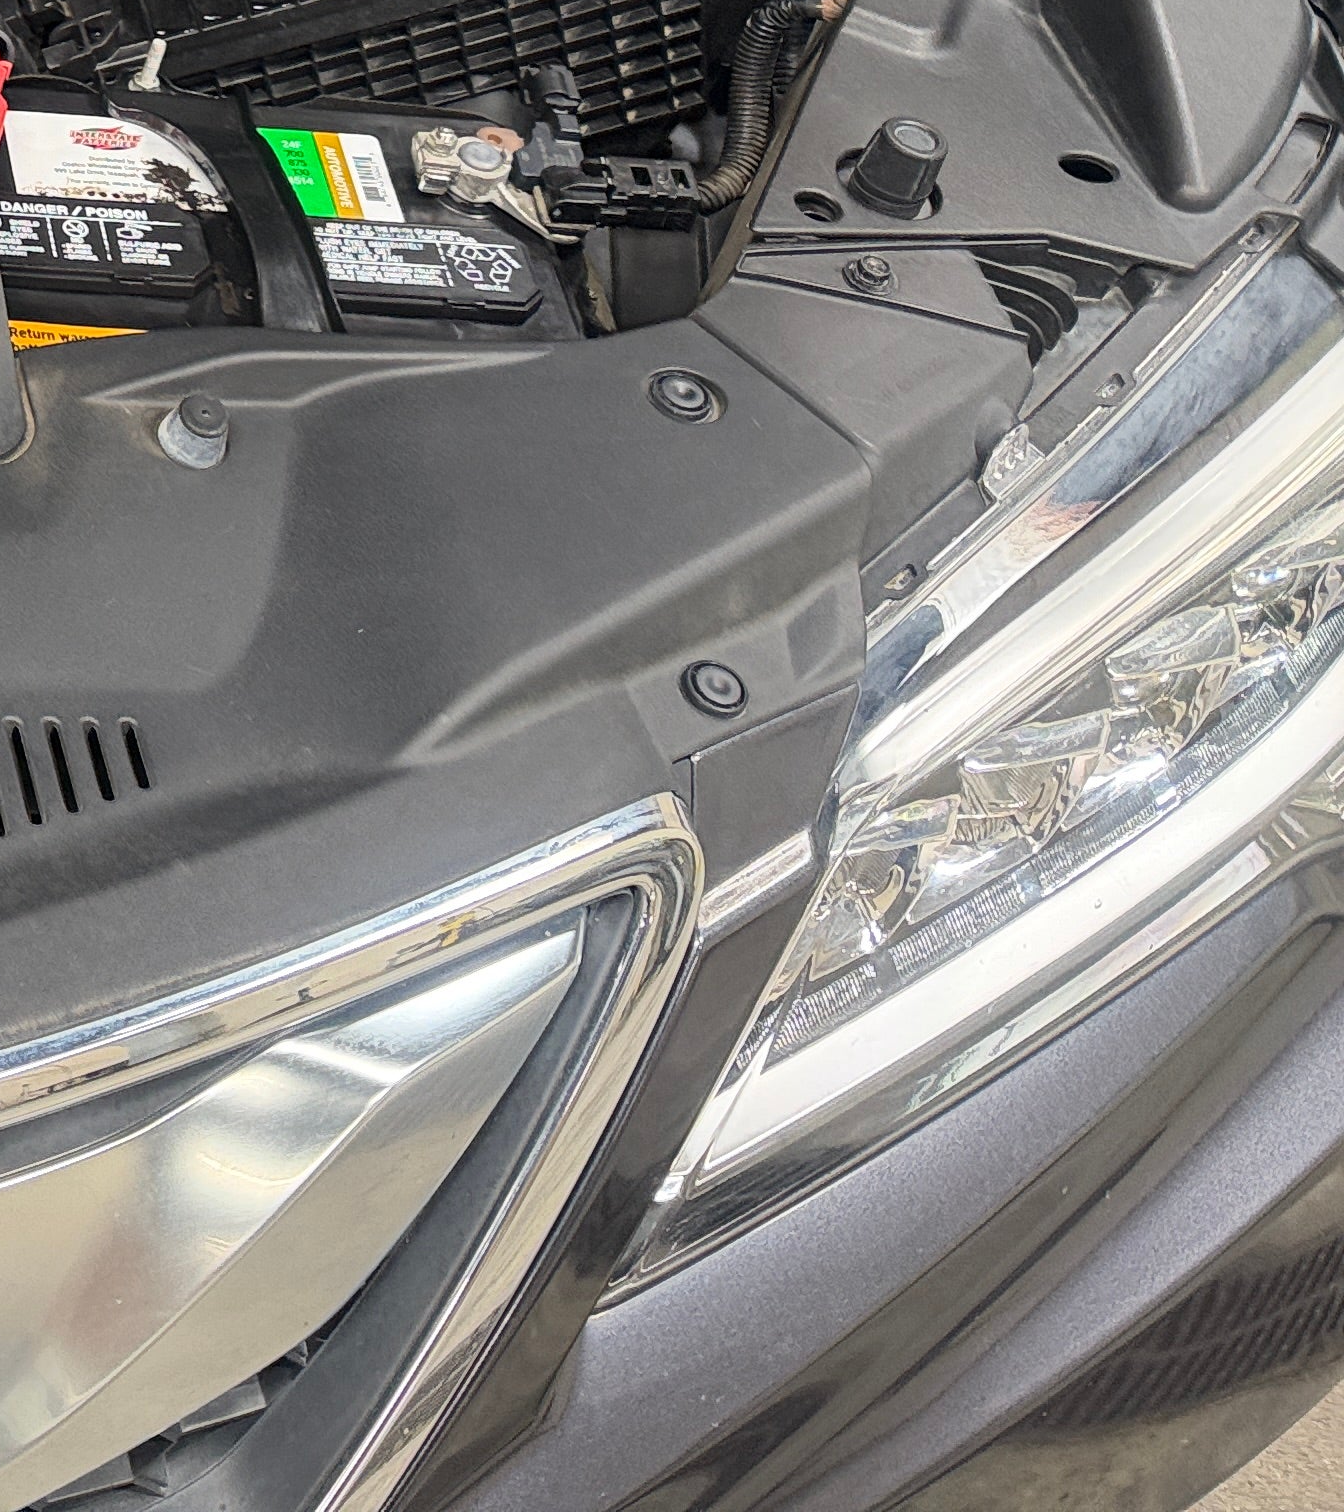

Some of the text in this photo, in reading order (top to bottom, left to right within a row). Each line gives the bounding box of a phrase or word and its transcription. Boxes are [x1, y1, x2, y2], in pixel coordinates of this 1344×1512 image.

[70, 129, 143, 142] INTERSTATE
[72, 138, 138, 148] BATTERIES
[282, 149, 304, 157] 700
[322, 145, 354, 209] AUTOMOTIVE
[0, 200, 68, 215] DANGER
[85, 206, 148, 221] POISON
[9, 327, 55, 341] Return
